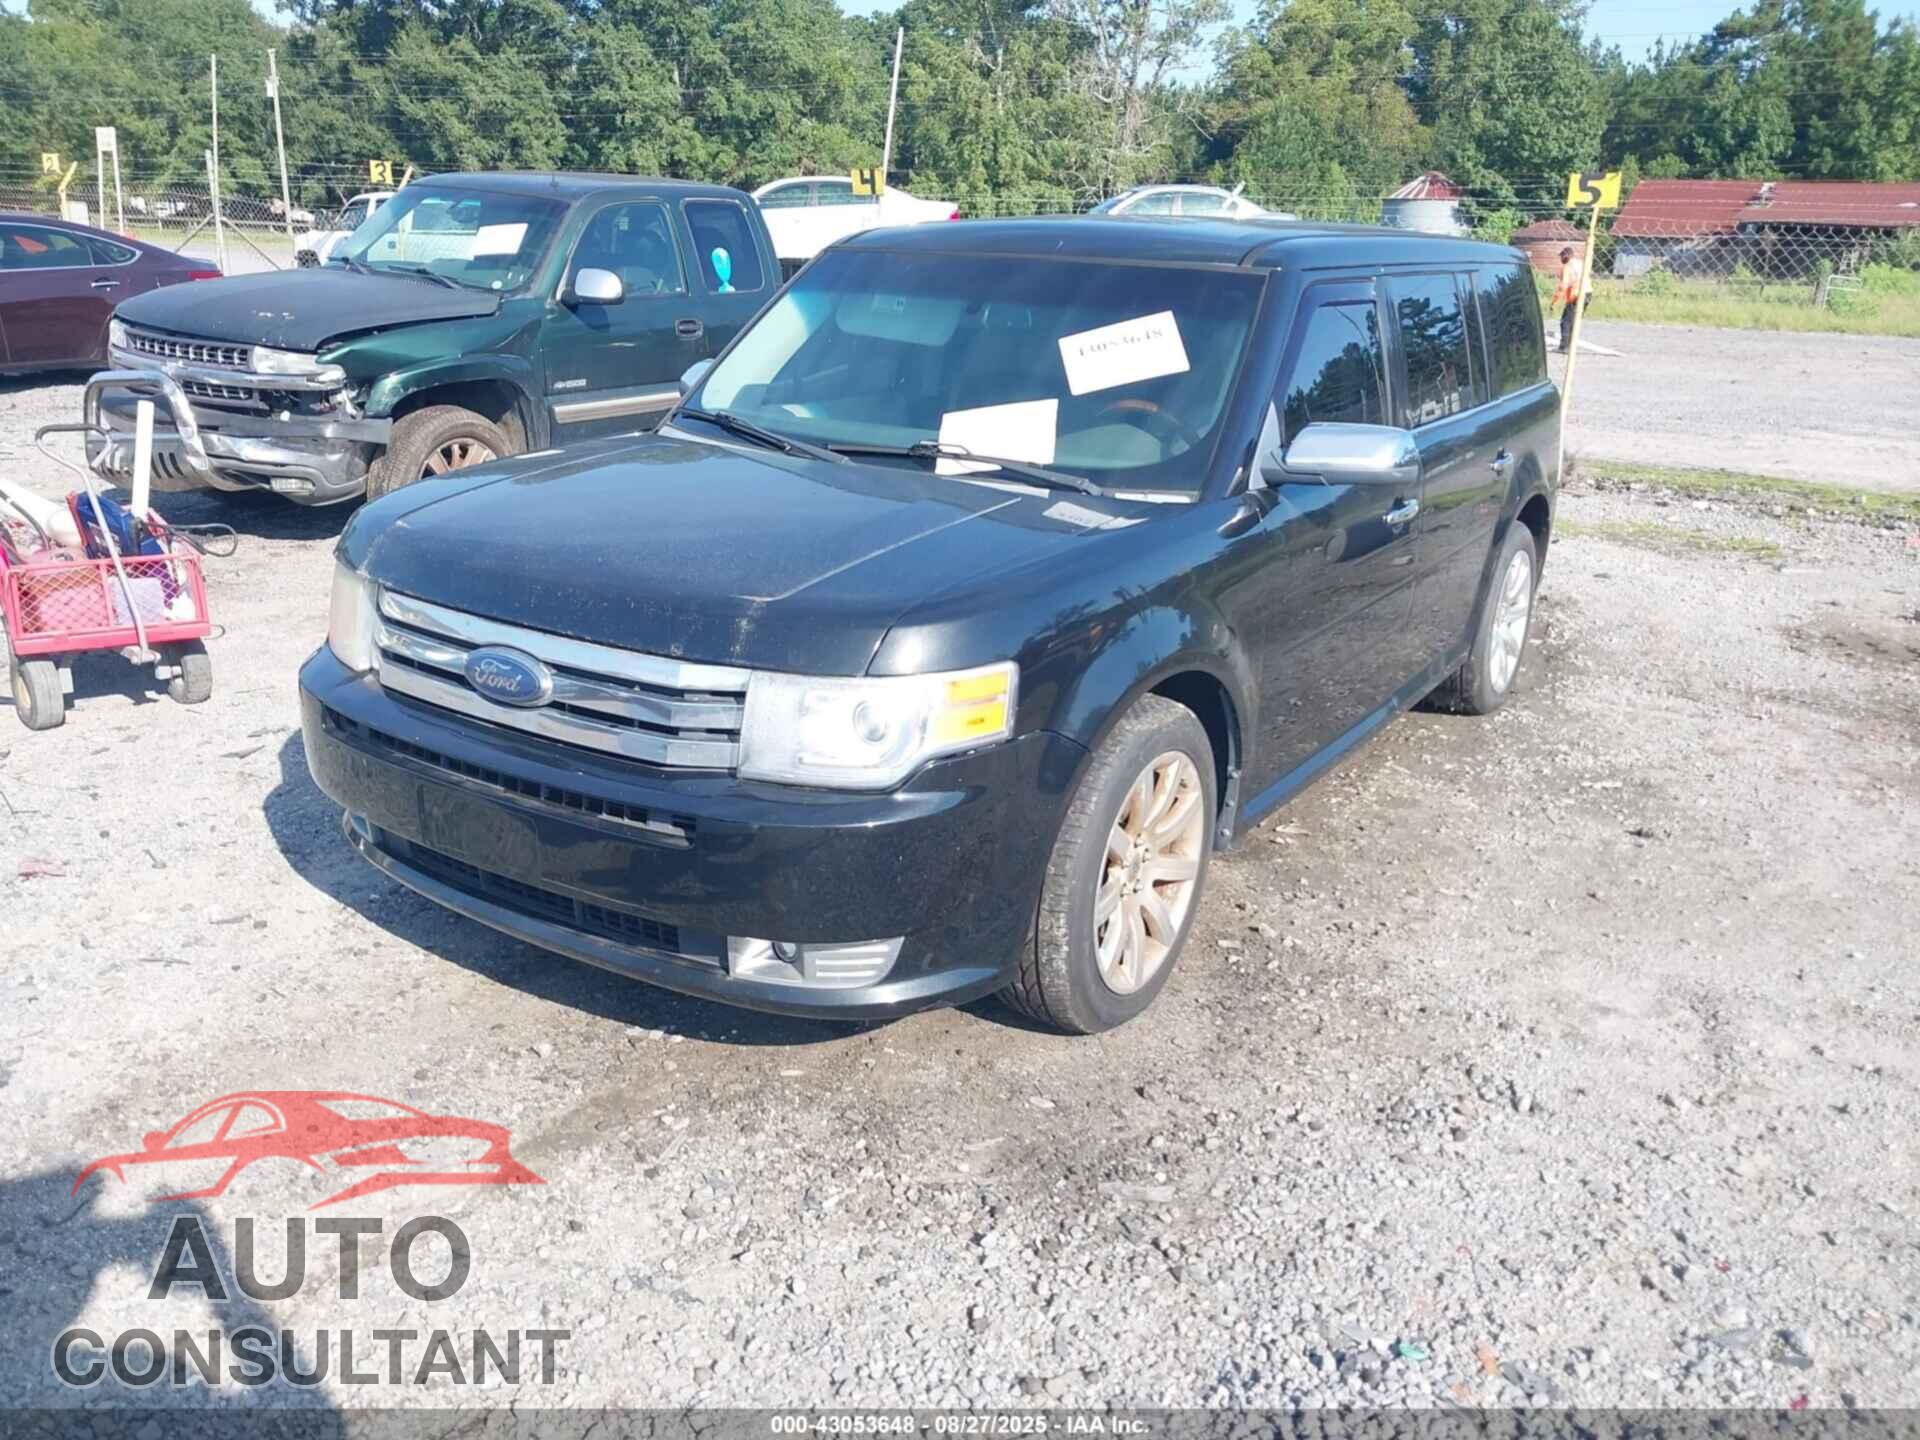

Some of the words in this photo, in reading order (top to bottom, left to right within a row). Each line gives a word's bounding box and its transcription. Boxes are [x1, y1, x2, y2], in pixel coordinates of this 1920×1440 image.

[374, 161, 387, 185] 3
[858, 168, 877, 195] 4
[1574, 170, 1606, 207] 5
[473, 658, 523, 692] Ford
